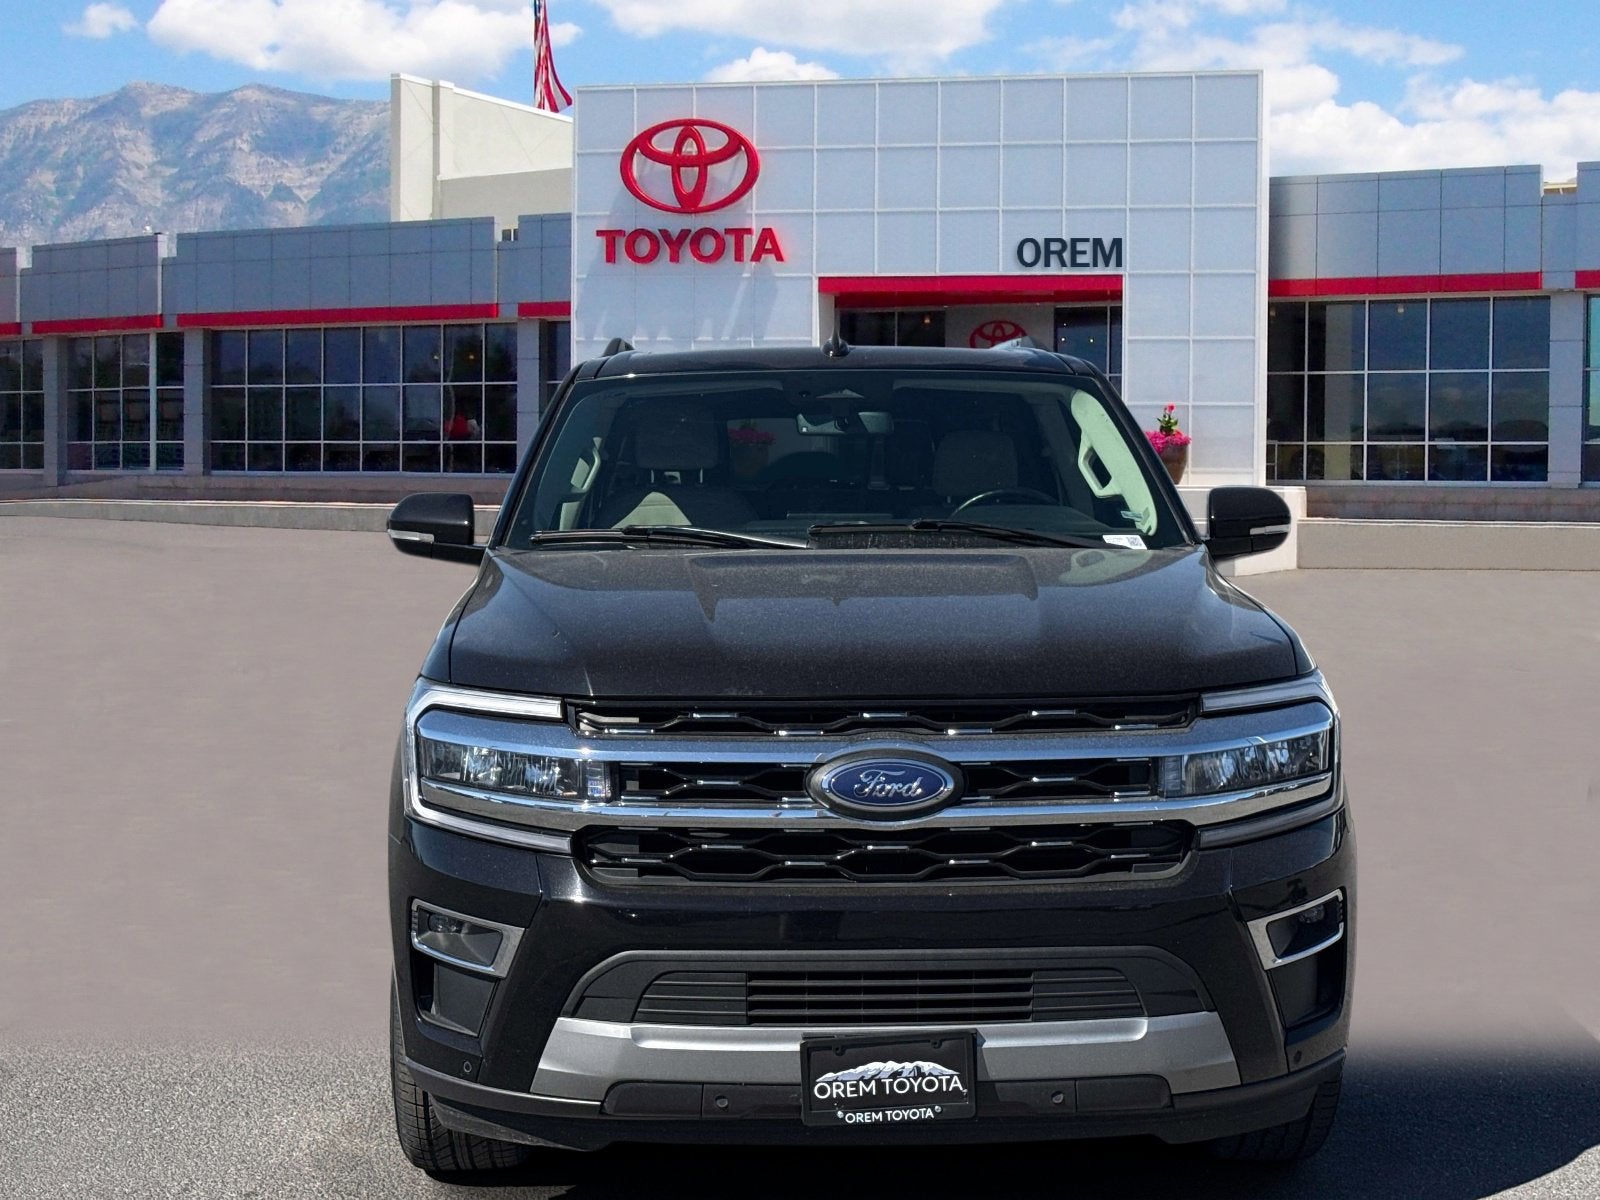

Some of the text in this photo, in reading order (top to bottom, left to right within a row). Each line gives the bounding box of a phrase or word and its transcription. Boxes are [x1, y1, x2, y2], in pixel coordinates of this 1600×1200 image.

[596, 227, 785, 264] TOYOTA
[1017, 237, 1123, 268] OREM
[854, 769, 924, 798] Ford
[813, 1076, 963, 1098] OREM TOYOTA
[845, 1107, 934, 1123] OREM TOYOTA
